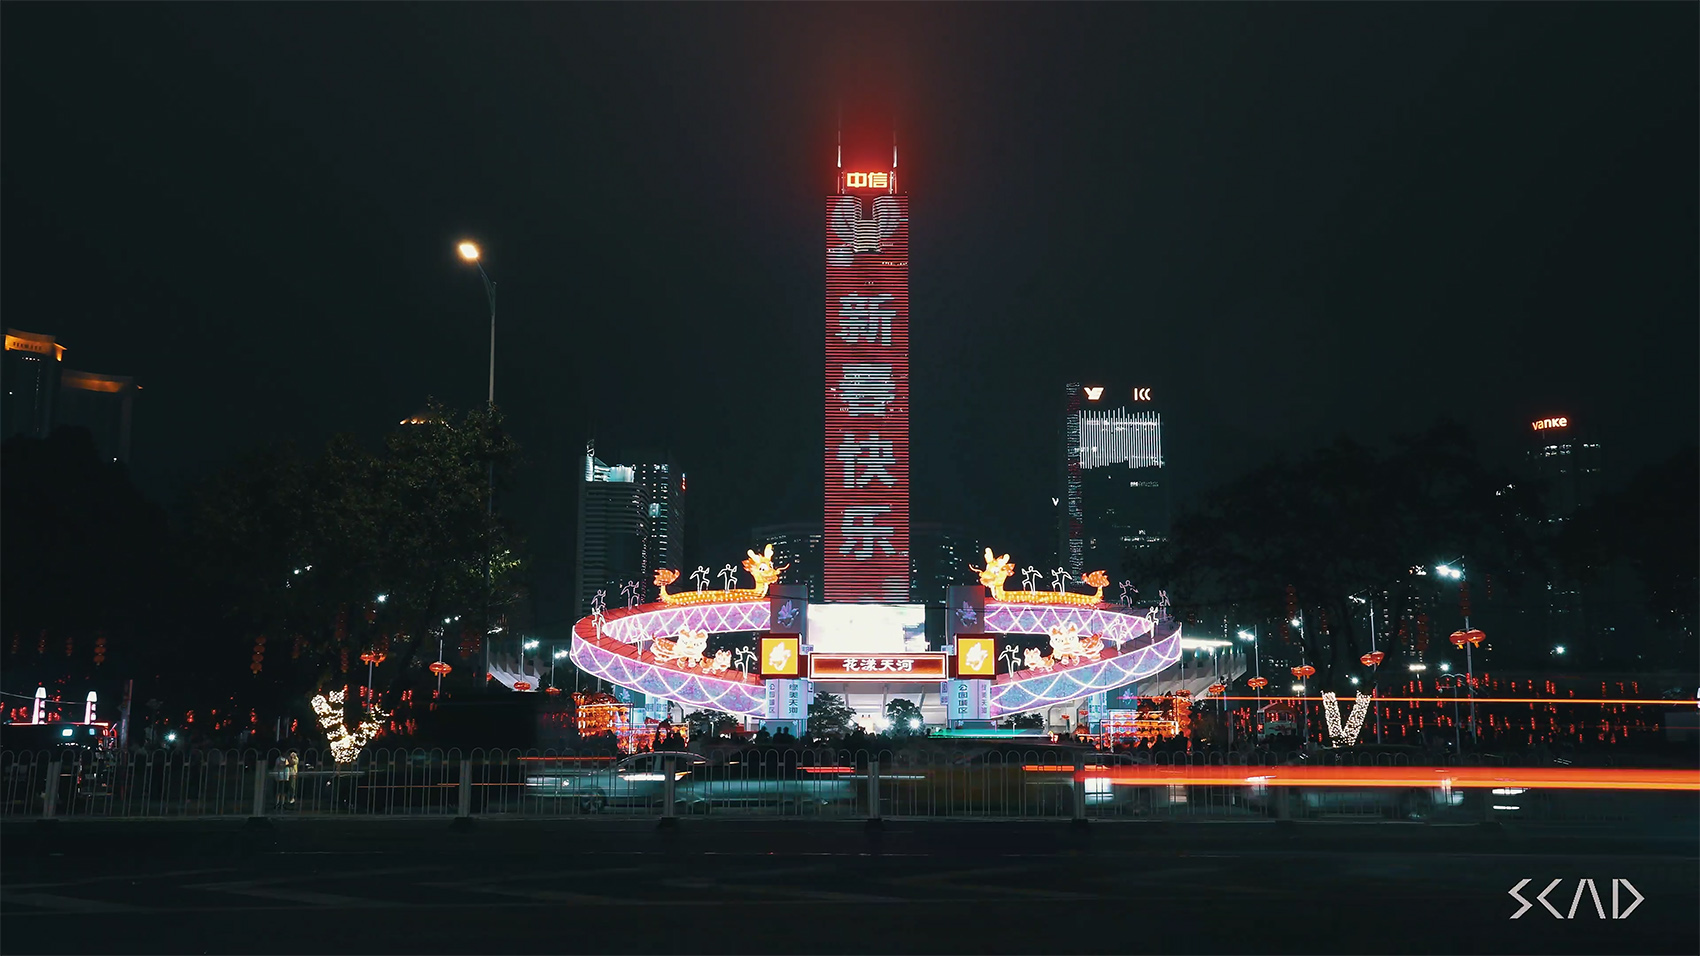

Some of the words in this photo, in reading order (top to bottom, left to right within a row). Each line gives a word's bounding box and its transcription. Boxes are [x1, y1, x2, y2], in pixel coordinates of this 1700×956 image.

[846, 171, 888, 188] 中信
[1133, 387, 1151, 401] ICC
[836, 291, 897, 560] 新春快乐
[1531, 416, 1568, 431] vanke
[843, 658, 914, 673] 花漾天河
